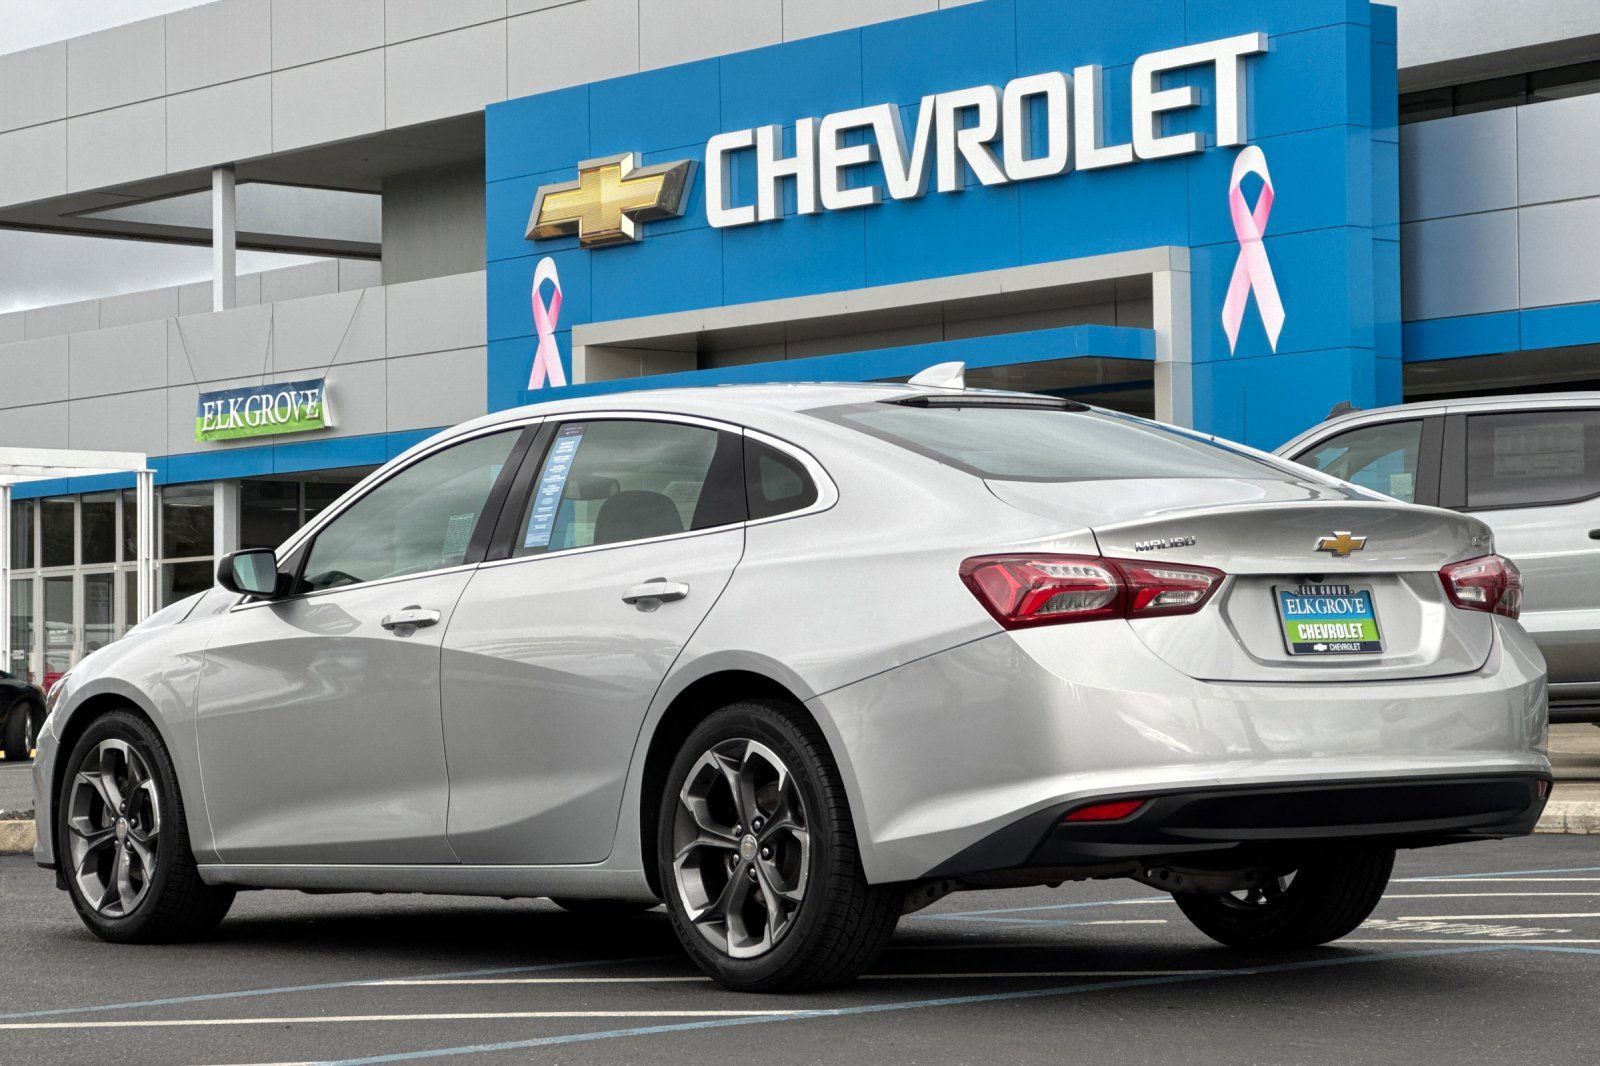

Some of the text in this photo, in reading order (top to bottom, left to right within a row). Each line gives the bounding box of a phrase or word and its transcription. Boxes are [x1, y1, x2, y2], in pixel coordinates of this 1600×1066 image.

[705, 32, 1267, 228] CHEVROLET
[202, 389, 319, 432] ELK GROVE
[1135, 536, 1196, 552] MALIBU
[1302, 586, 1348, 595] ELK GROVE
[1286, 598, 1366, 614] ELK GROVE
[1298, 623, 1363, 639] CHEVROLET
[1330, 643, 1361, 651] CHEVROLET
